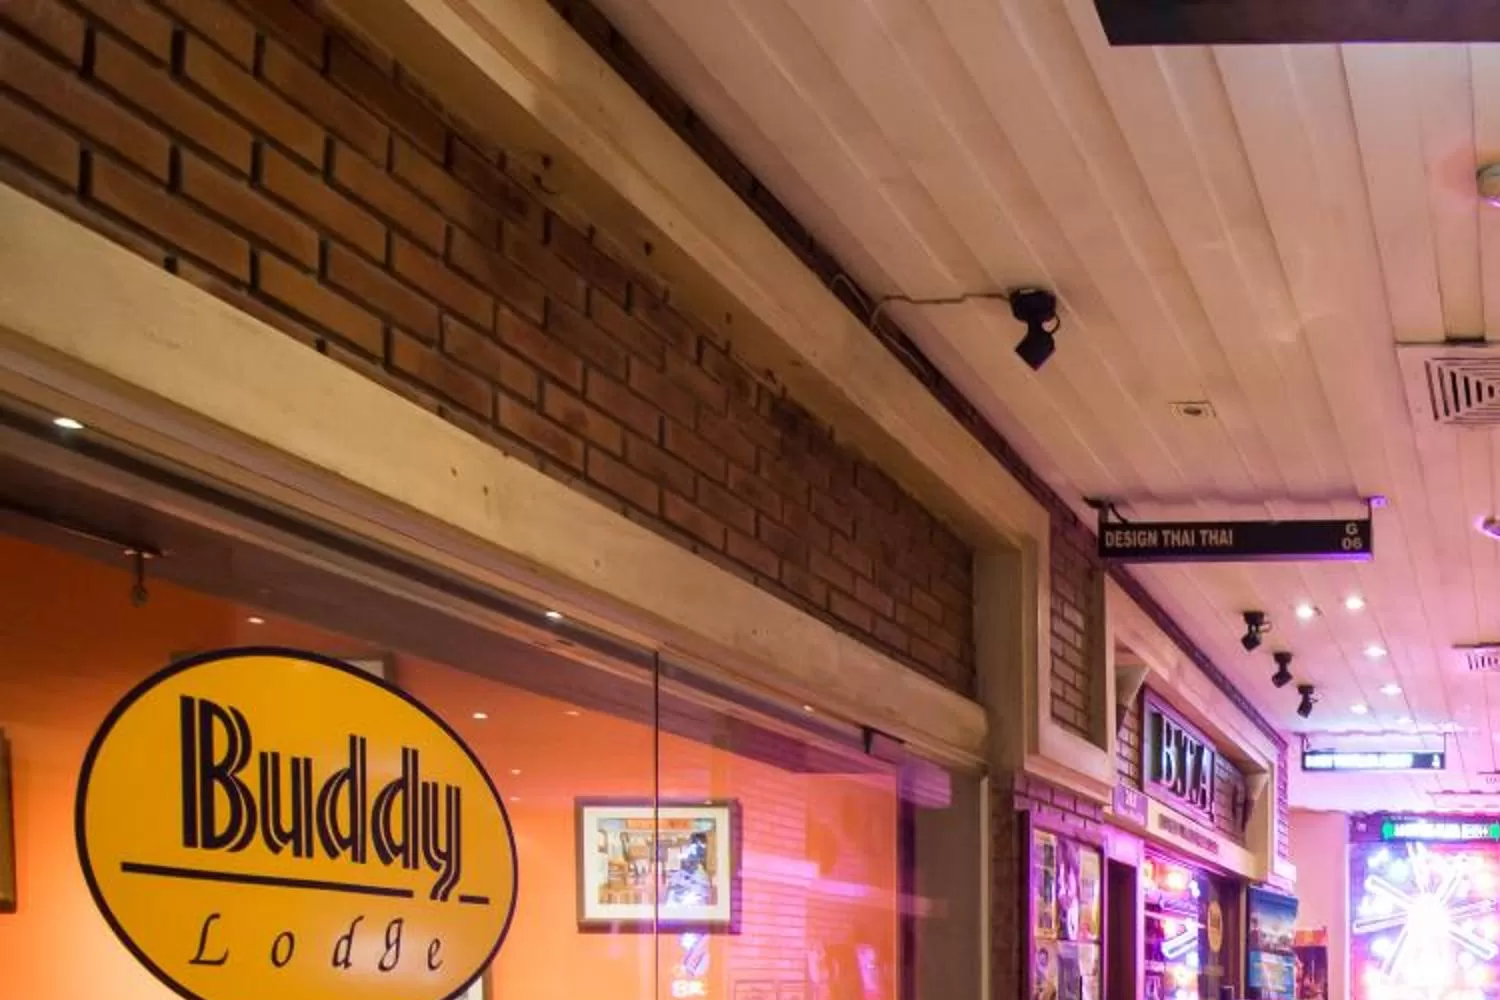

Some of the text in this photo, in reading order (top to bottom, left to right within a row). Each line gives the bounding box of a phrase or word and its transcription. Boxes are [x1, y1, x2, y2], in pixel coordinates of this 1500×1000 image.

[1104, 528, 1234, 548] DESIGN THAI THAI
[1345, 523, 1359, 535] G
[1341, 536, 1363, 550] 06
[180, 695, 462, 902] Buddy
[188, 912, 445, 973] Lodge
